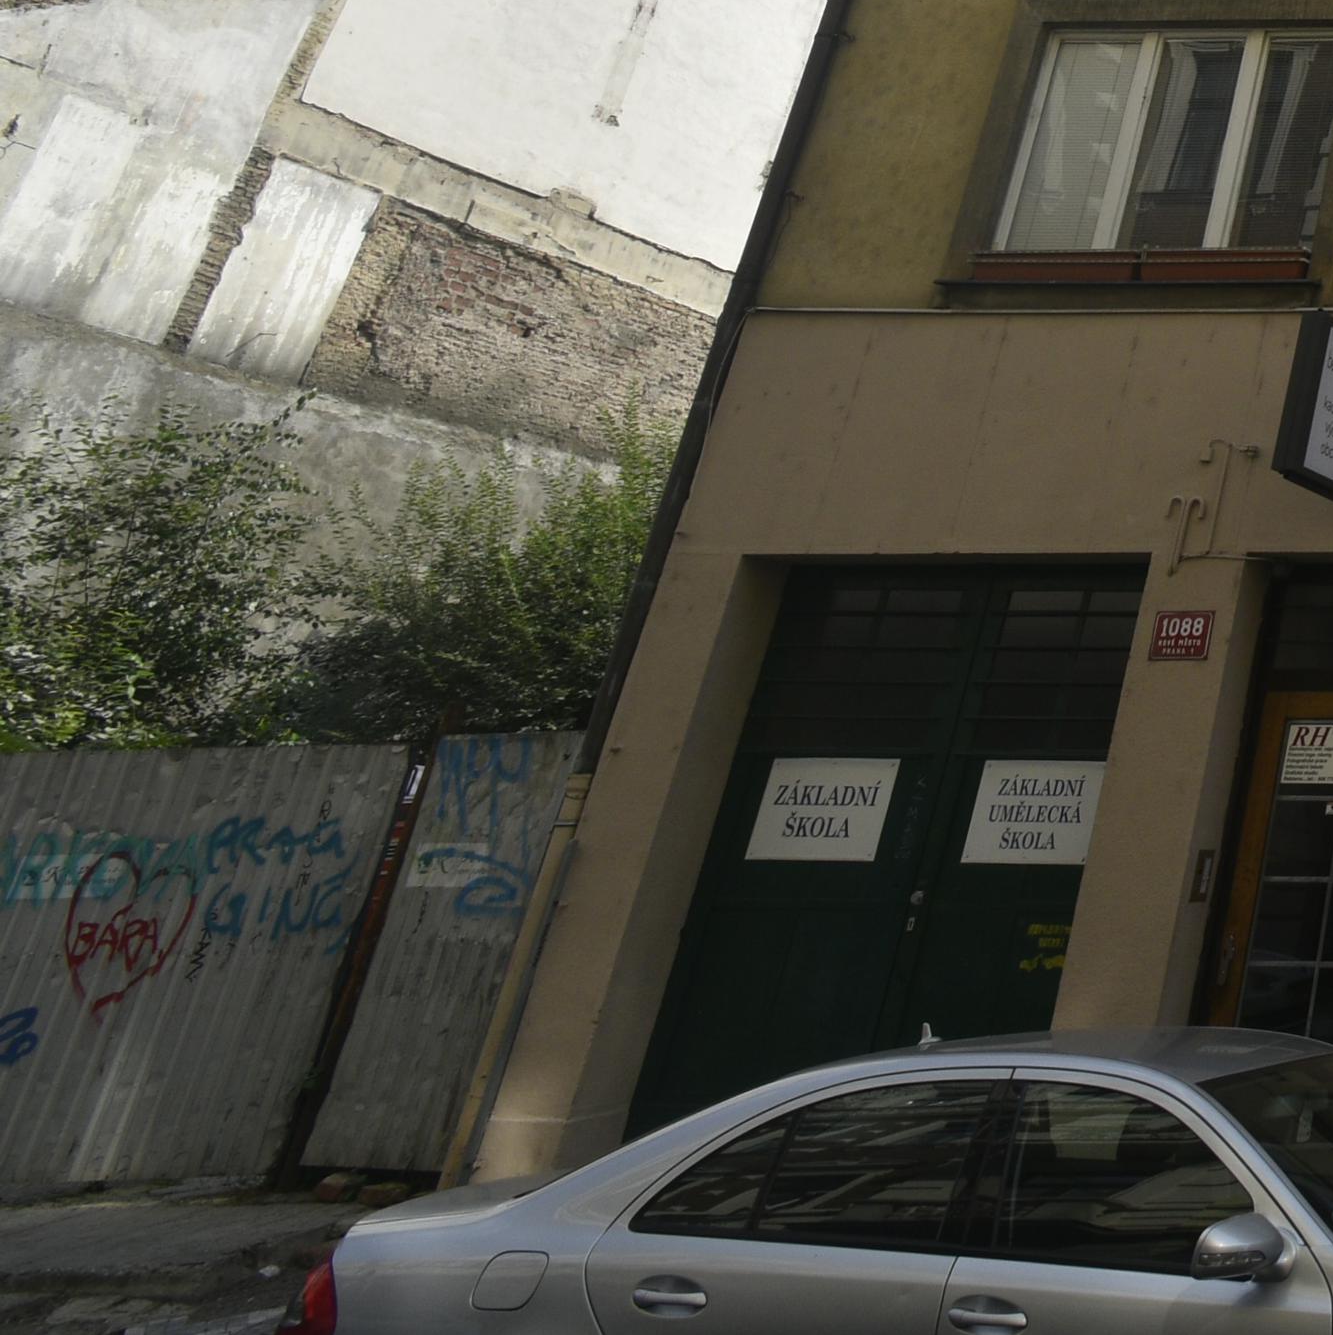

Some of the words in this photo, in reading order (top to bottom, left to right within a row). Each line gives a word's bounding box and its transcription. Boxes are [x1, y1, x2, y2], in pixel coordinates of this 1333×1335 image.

[1160, 617, 1205, 638] 1088
[1291, 726, 1332, 747] RH
[773, 780, 882, 807] ZÁKLADNÍ
[998, 774, 1086, 797] ZÁKLADNÍ
[988, 801, 1082, 824] UMĚLECKÁ
[782, 812, 850, 839] ŠKOLA
[998, 827, 1056, 850] ŠKOLA
